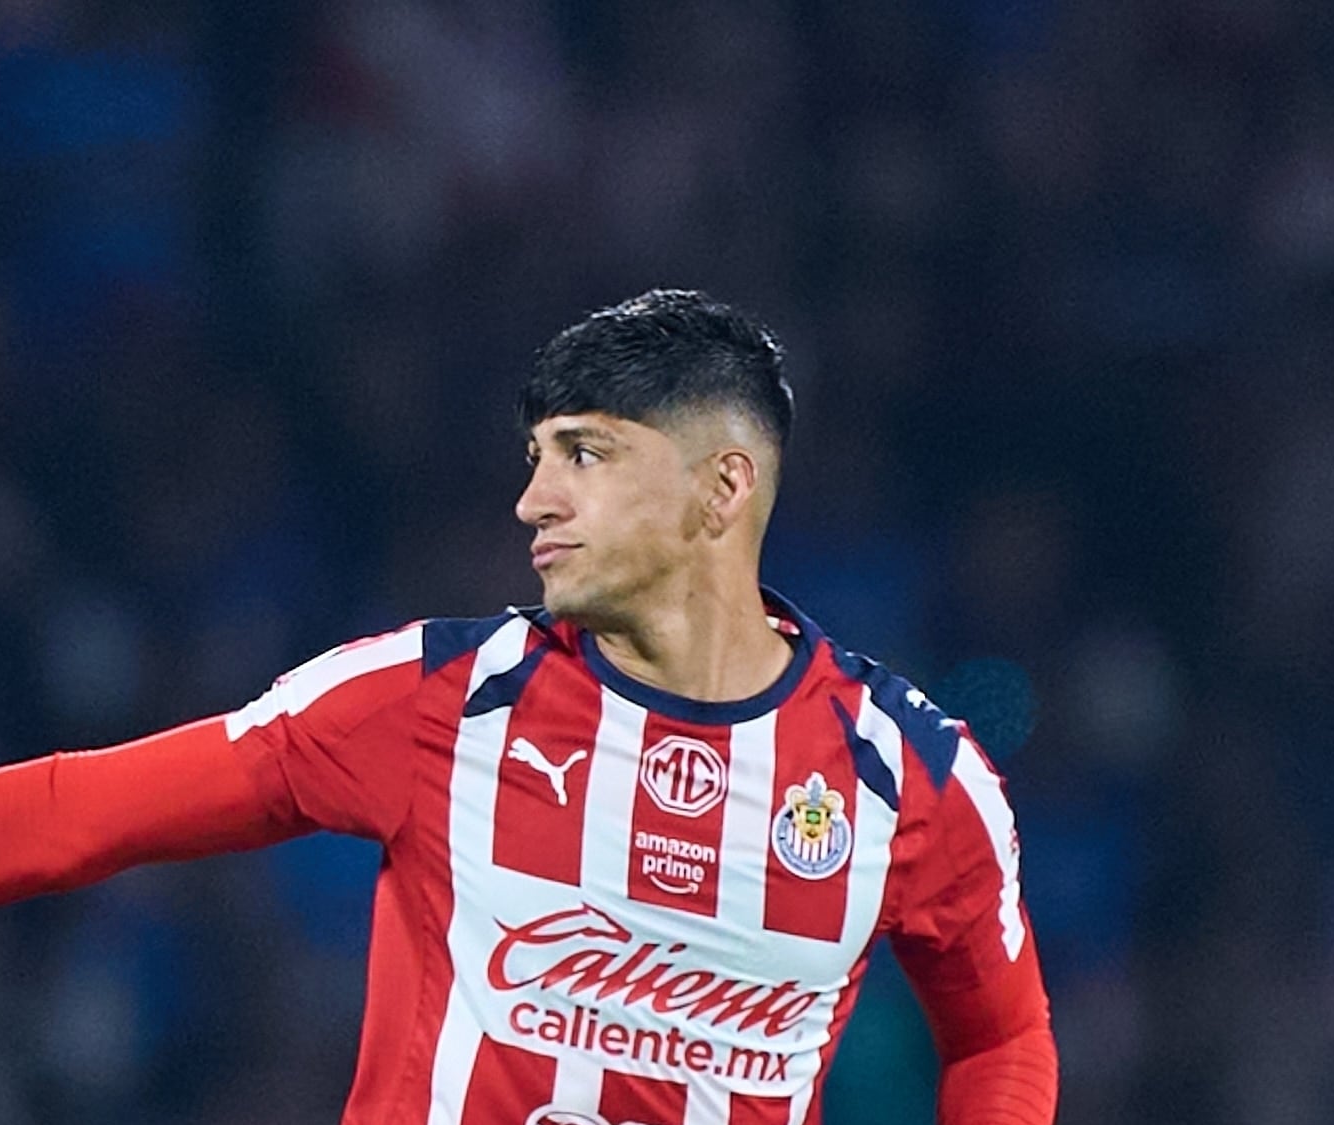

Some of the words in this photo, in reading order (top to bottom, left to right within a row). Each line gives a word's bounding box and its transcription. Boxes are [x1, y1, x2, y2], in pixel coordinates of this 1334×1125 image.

[635, 831, 716, 863] amazon
[642, 854, 704, 882] prime
[487, 902, 820, 1037] Caliente
[510, 1002, 788, 1081] caliente.mx
